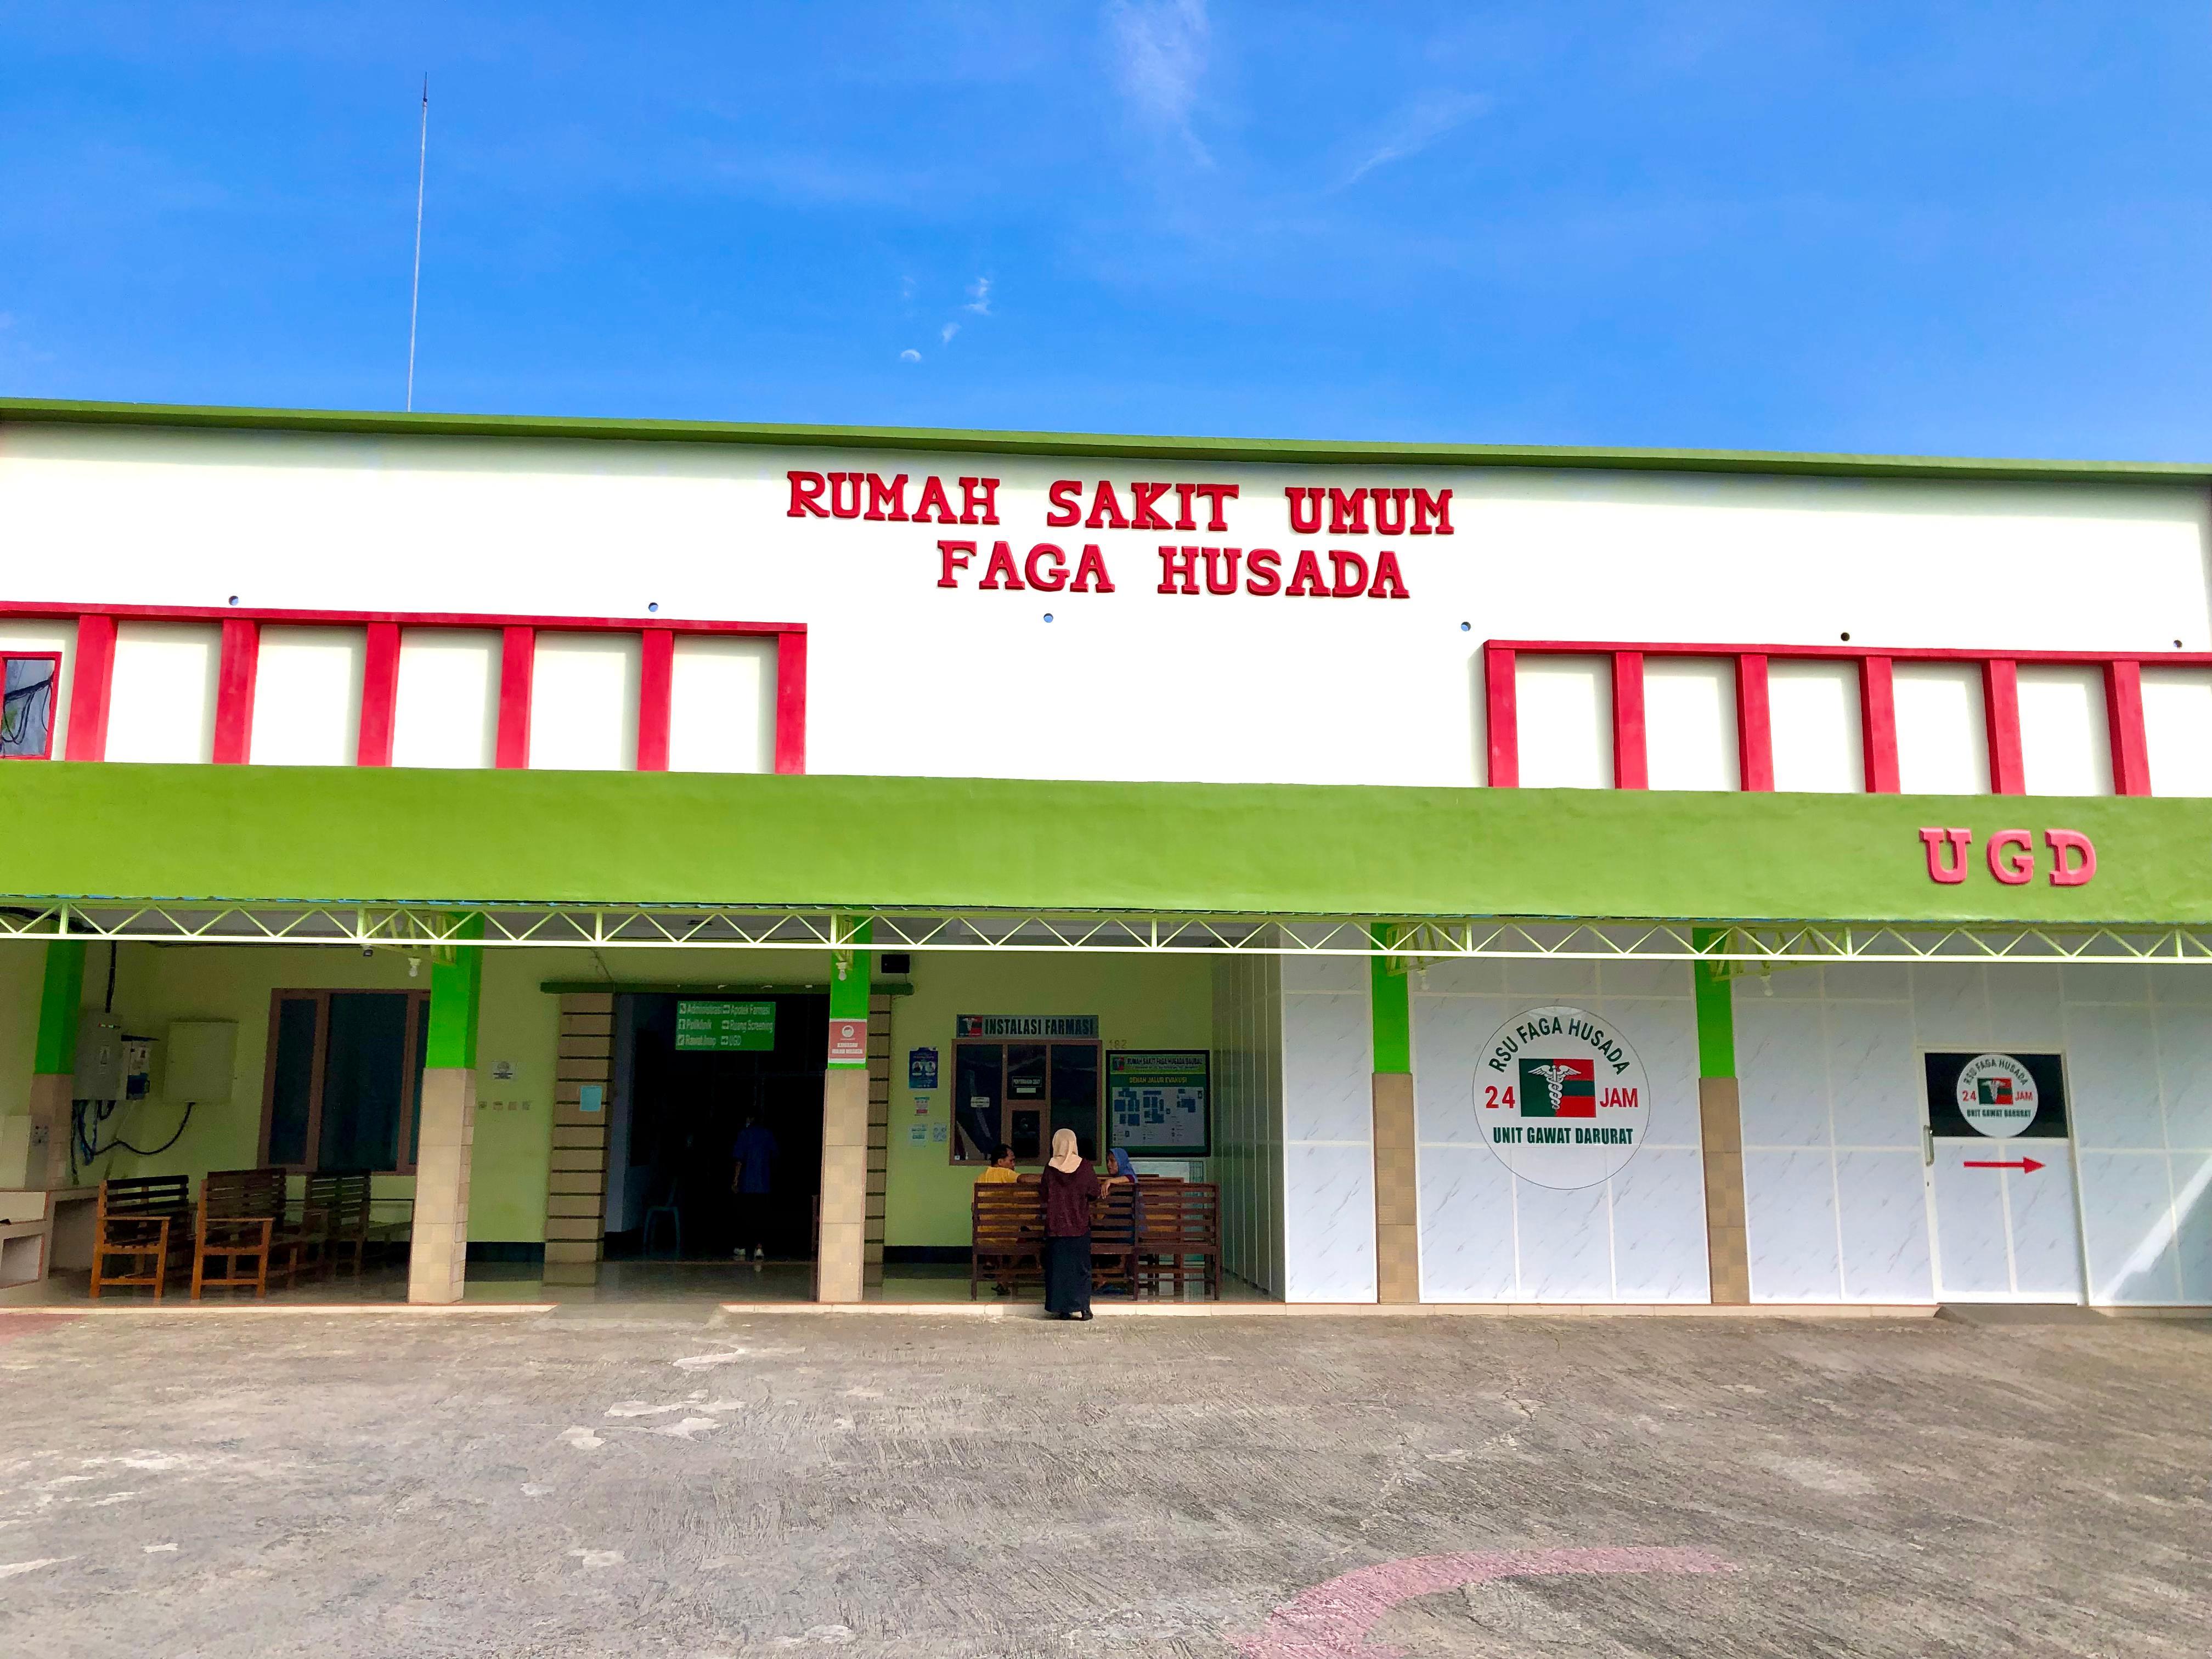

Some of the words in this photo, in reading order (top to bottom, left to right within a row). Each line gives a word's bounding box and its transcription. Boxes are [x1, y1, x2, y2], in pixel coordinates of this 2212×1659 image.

[787, 471, 1000, 525] RUMAH
[1047, 480, 1239, 531] SAKIT
[1285, 487, 1454, 536] UMUM
[937, 540, 1115, 592] FAGA
[1158, 545, 1410, 599] HUSADA
[1919, 827, 2097, 887] UGD
[985, 1019, 1041, 1035] INSTALASI
[1045, 1019, 1093, 1035] FARMASI
[729, 1035, 742, 1046] UGD
[1488, 1036, 1519, 1073] RSU
[1516, 1017, 1562, 1044] FAGA
[1568, 1018, 1630, 1075] HUSADA
[1976, 1059, 1997, 1071] FAGA
[1999, 1059, 2028, 1085] HUSADA
[1485, 1086, 1515, 1109] 24
[1600, 1087, 1638, 1108] JAM
[1962, 1090, 1976, 1102] 24
[2015, 1091, 2033, 1102] JAM
[1967, 1109, 1980, 1117] UNIT
[1982, 1109, 2002, 1118] GAWAT
[2004, 1109, 2032, 1118] DARURAT
[1493, 1127, 1523, 1143] UNIT
[1527, 1127, 1571, 1144] GAWAT
[1576, 1127, 1633, 1144] DARURAT
